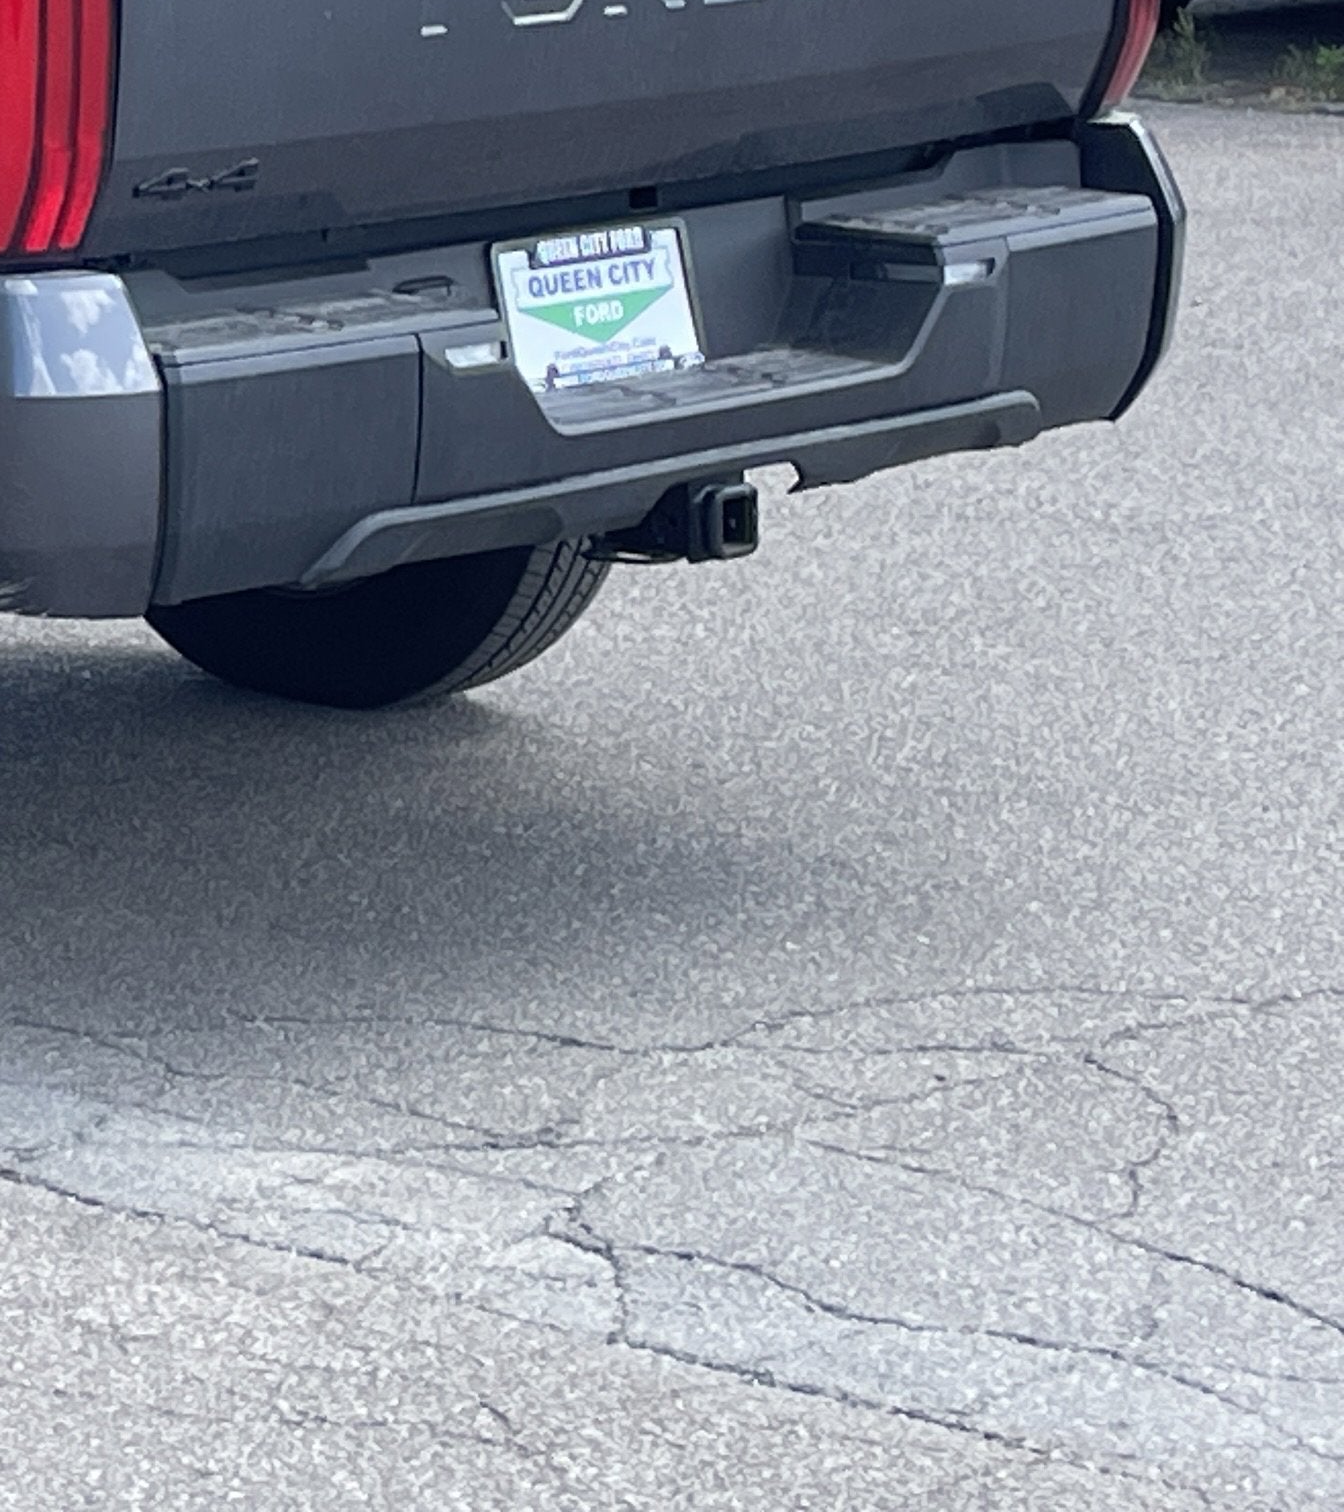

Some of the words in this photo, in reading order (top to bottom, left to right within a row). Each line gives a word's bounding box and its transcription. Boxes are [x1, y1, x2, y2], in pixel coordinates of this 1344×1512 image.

[528, 268, 601, 297] QUEEN
[609, 259, 656, 285] CITY
[573, 300, 624, 326] FORD
